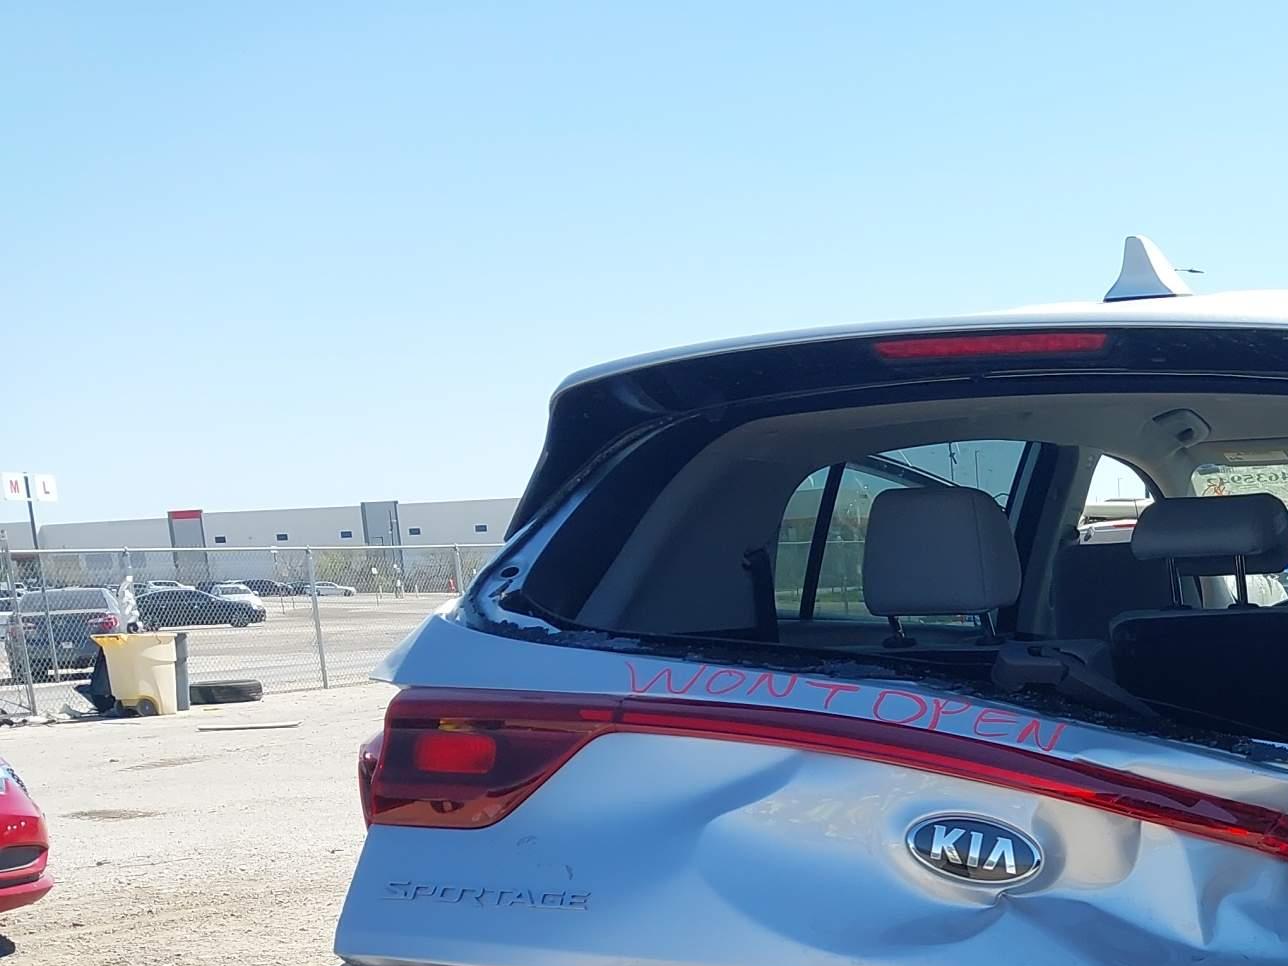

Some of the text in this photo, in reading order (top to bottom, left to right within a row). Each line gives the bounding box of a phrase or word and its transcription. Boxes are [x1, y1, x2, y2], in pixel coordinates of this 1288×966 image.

[9, 479, 20, 494] M
[42, 480, 50, 495] L
[872, 690, 1068, 752] OPEN
[930, 824, 1017, 875] KIA
[383, 880, 592, 910] SPORTAGE
